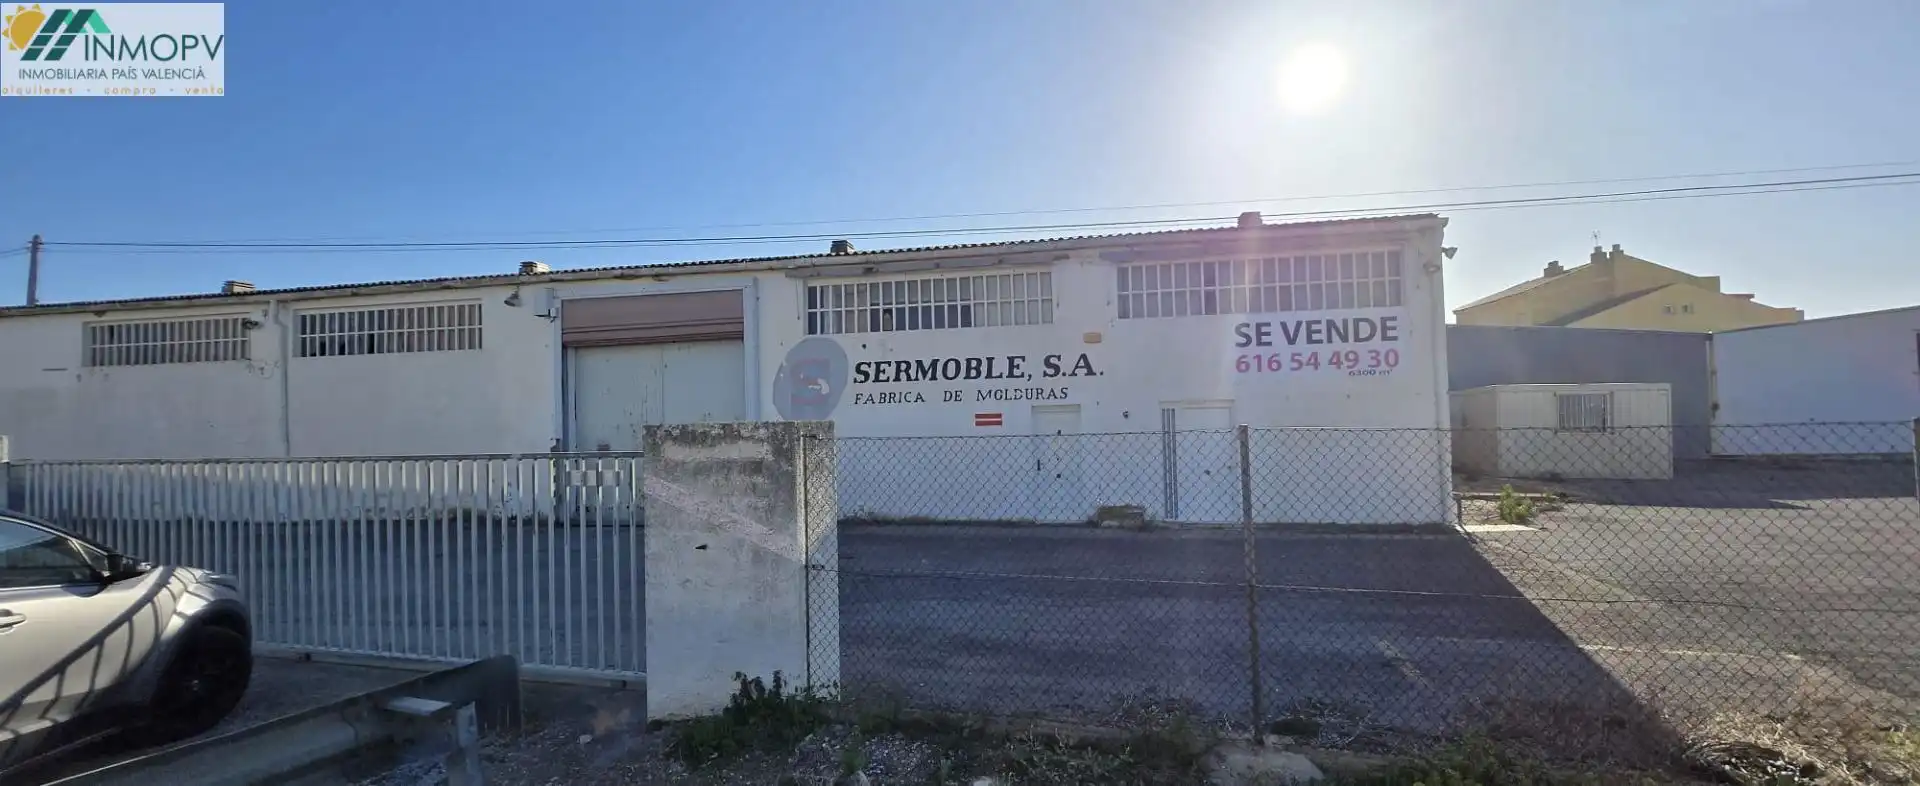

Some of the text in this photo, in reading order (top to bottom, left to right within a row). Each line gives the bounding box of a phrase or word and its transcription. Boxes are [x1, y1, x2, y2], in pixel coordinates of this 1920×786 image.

[1234, 316, 1398, 348] SE VENDE
[853, 352, 1104, 384] SERMOBLE, S.A.
[1235, 348, 1399, 373] 616 54 49 30
[853, 387, 1069, 405] FABRICA DE MOLDURAS
